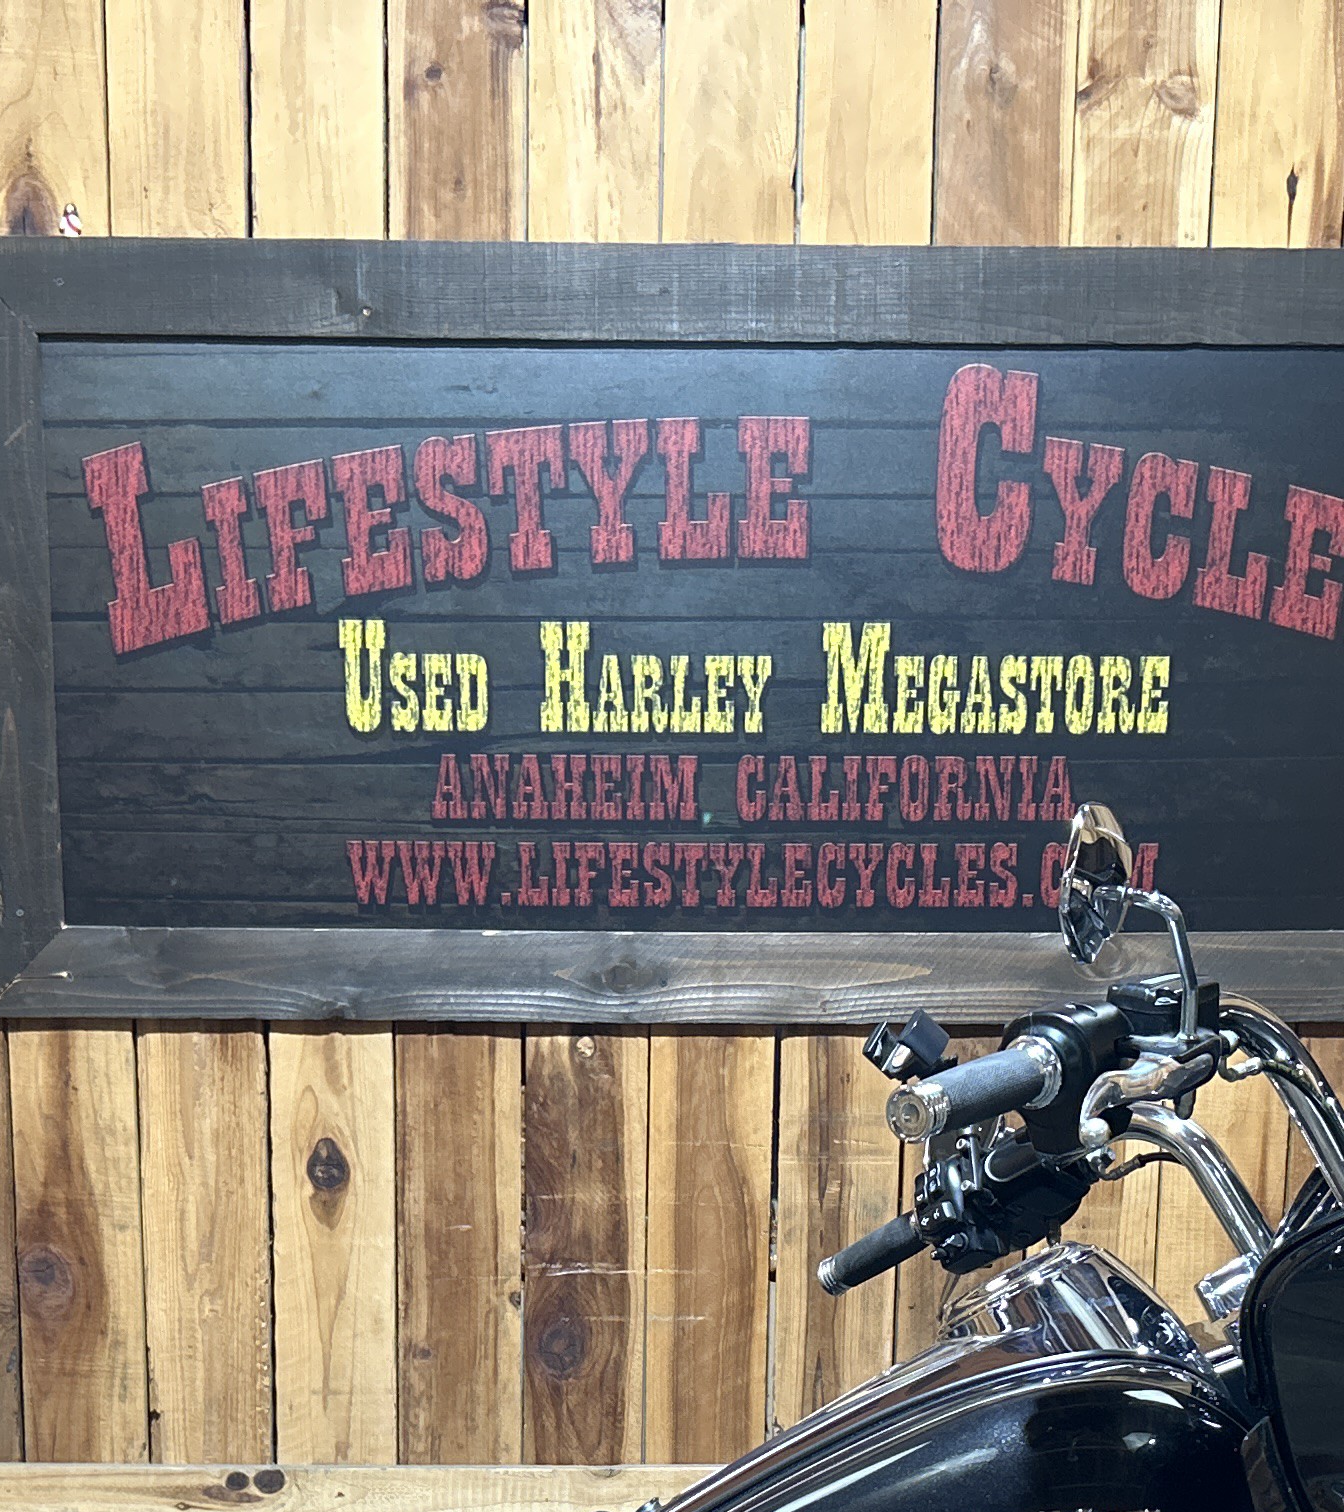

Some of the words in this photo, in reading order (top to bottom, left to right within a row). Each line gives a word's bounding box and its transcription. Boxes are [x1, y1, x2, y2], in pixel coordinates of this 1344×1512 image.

[82, 415, 811, 655] LIFESTYLE
[338, 619, 489, 733] USED
[539, 621, 772, 734] HARLEY
[820, 622, 1171, 735] MEGASTORE
[736, 755, 1075, 822] CALIFORNIA
[346, 840, 1159, 909] WWW.LIFESTYLECYCLES.CM
